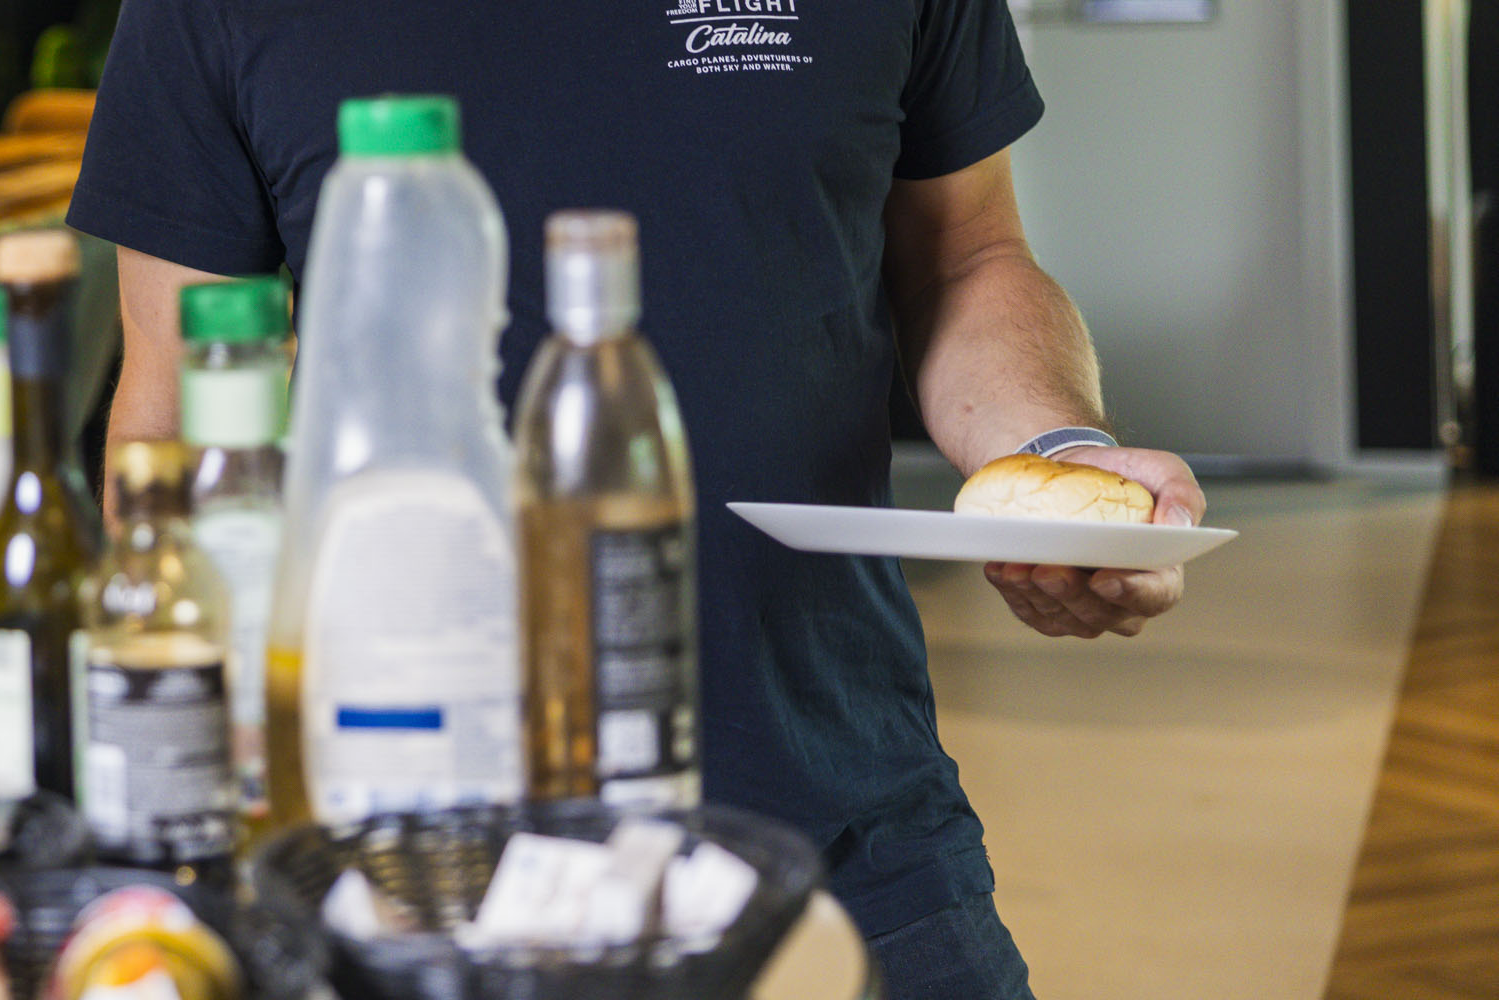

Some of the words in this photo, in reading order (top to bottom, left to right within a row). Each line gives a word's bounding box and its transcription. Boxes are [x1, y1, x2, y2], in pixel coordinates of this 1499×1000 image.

[666, 8, 698, 16] FREEDOM
[685, 21, 792, 54] Catalina
[667, 57, 699, 69] CARGO
[741, 54, 801, 64] ADVENTURERS
[802, 55, 813, 64] OF
[695, 65, 721, 74] BOTH
[723, 64, 740, 73] SKY
[742, 63, 761, 72] AND
[762, 62, 794, 72] WATER.
